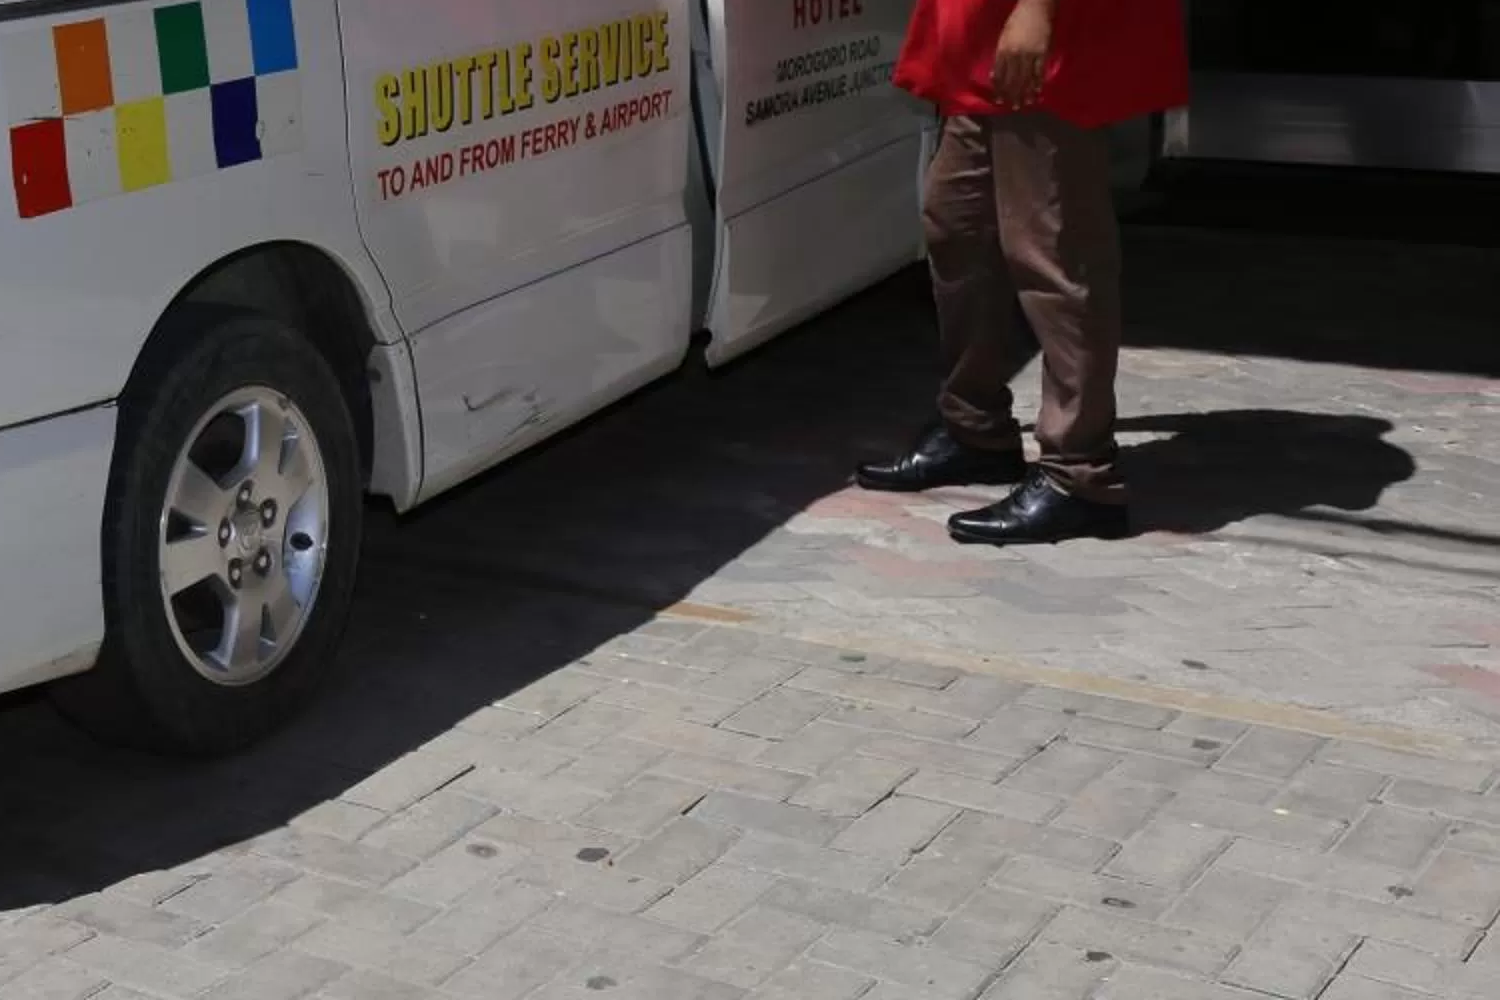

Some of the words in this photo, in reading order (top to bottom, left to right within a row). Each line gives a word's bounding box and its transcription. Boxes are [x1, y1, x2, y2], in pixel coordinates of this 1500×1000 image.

[374, 41, 534, 147] SHUTTLE
[540, 10, 669, 103] SERVICE
[377, 166, 406, 201] TO
[409, 153, 453, 192] AND
[459, 136, 516, 176] FROM
[520, 116, 581, 159] FERRY
[584, 111, 598, 139] &
